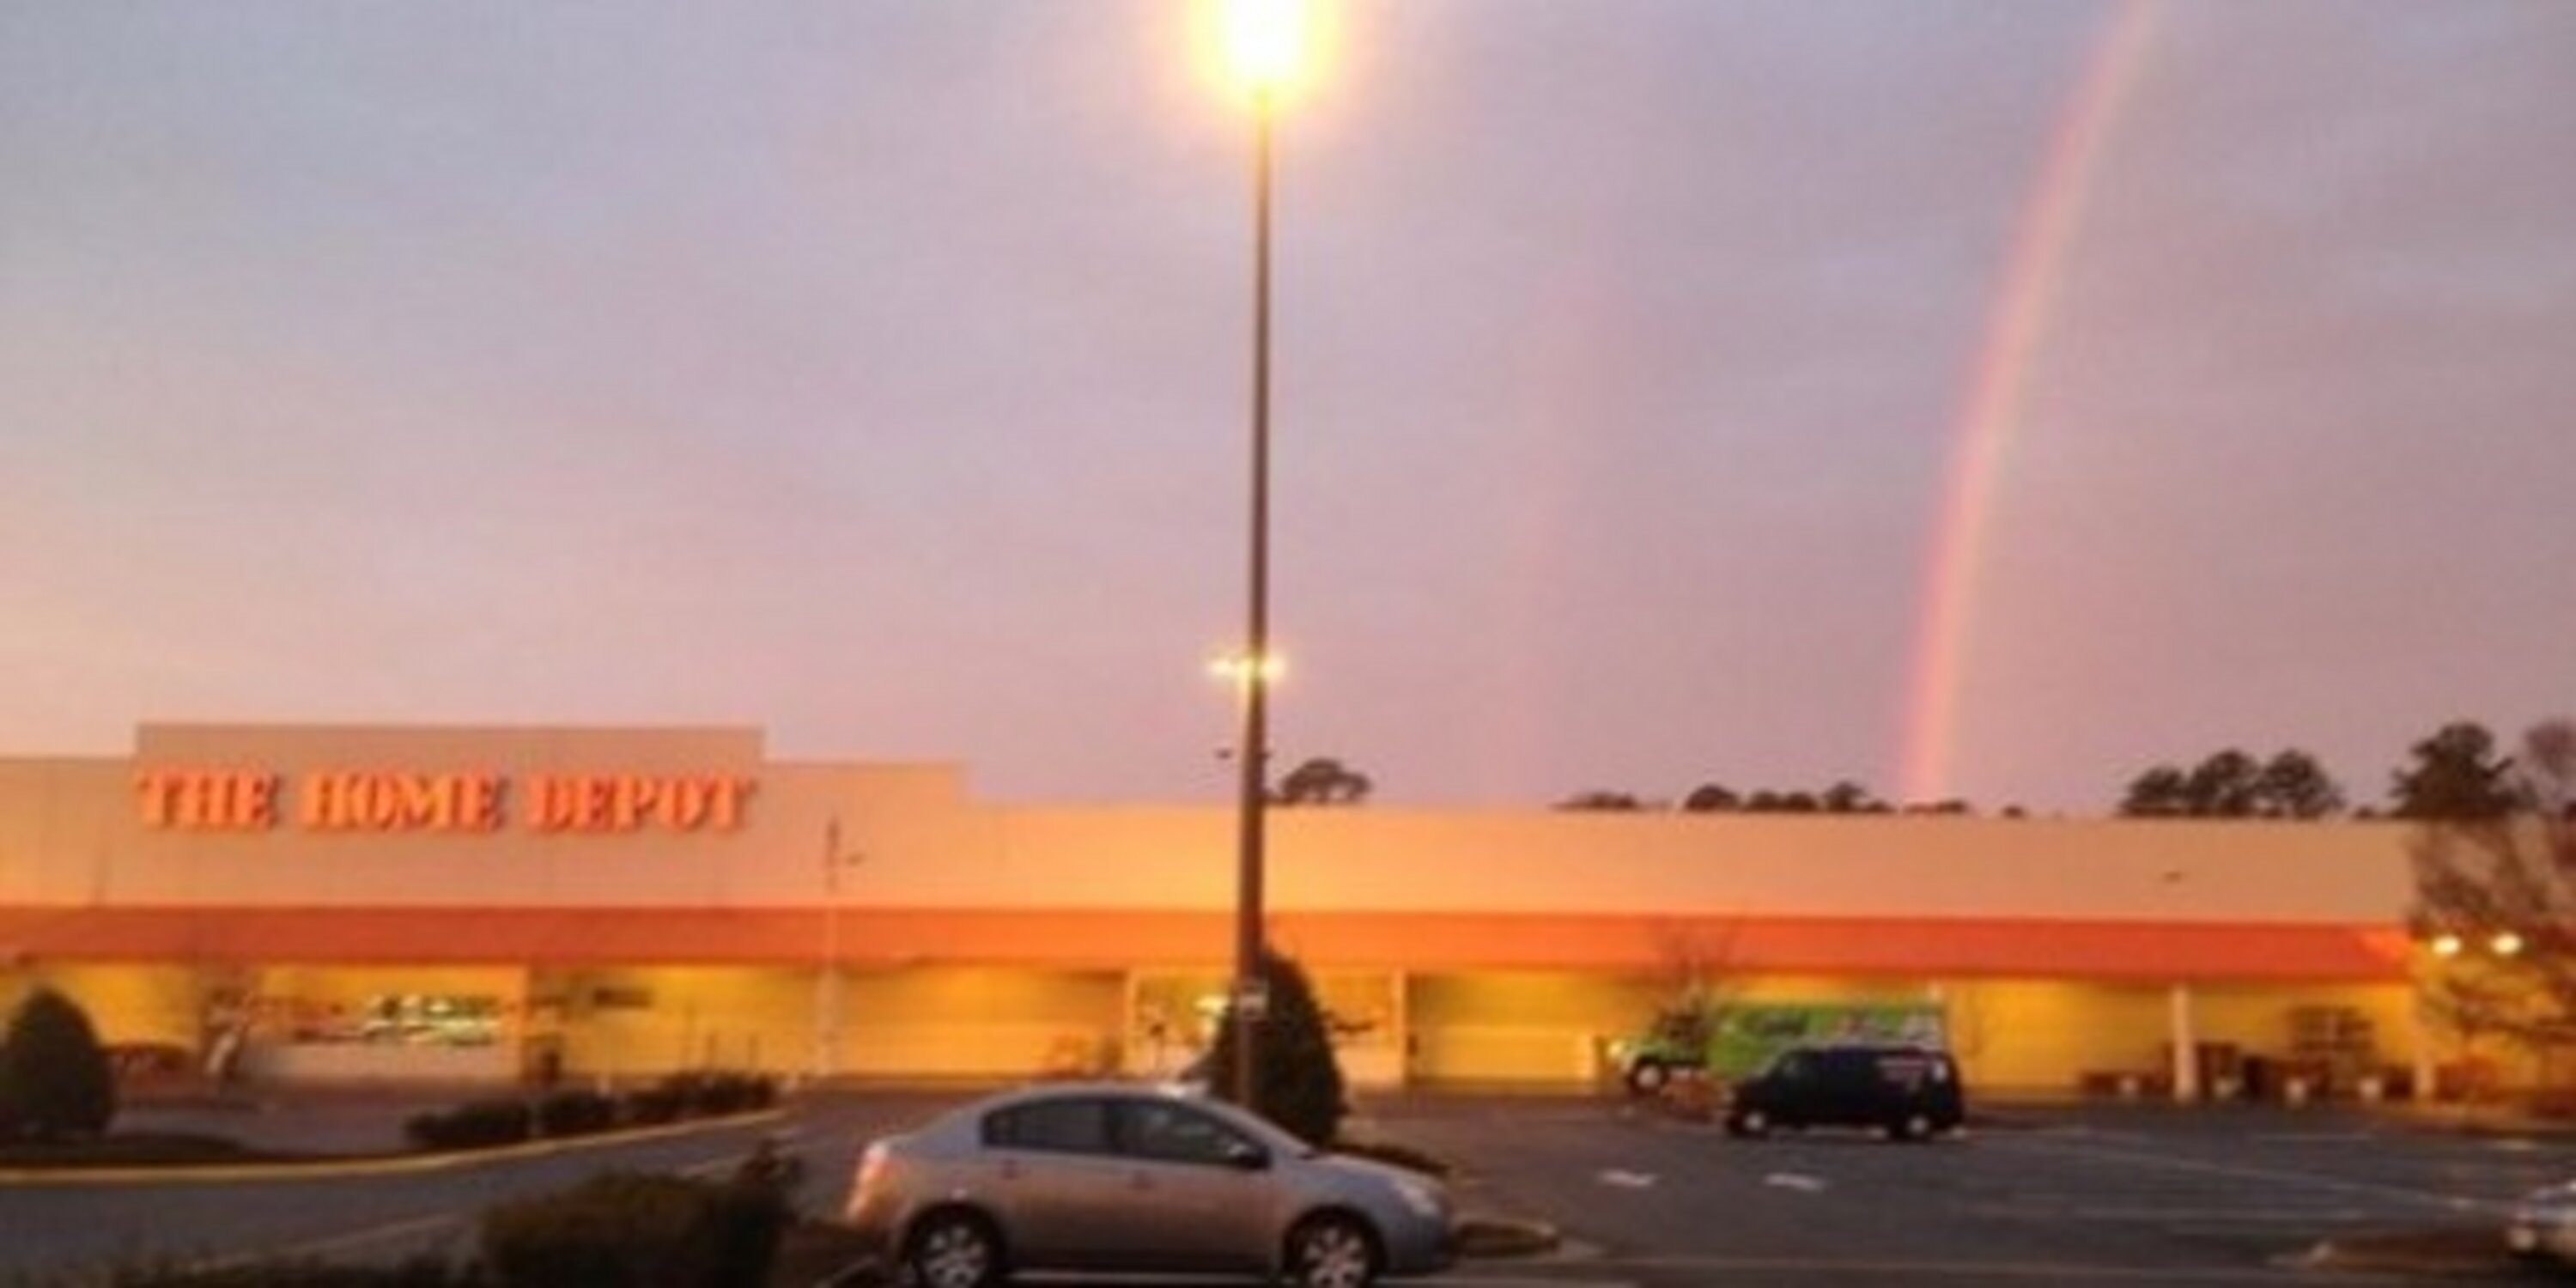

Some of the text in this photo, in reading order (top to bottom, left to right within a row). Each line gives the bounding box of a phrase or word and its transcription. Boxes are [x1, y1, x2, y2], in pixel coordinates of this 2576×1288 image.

[137, 770, 756, 832] THE HOME DEPOT
